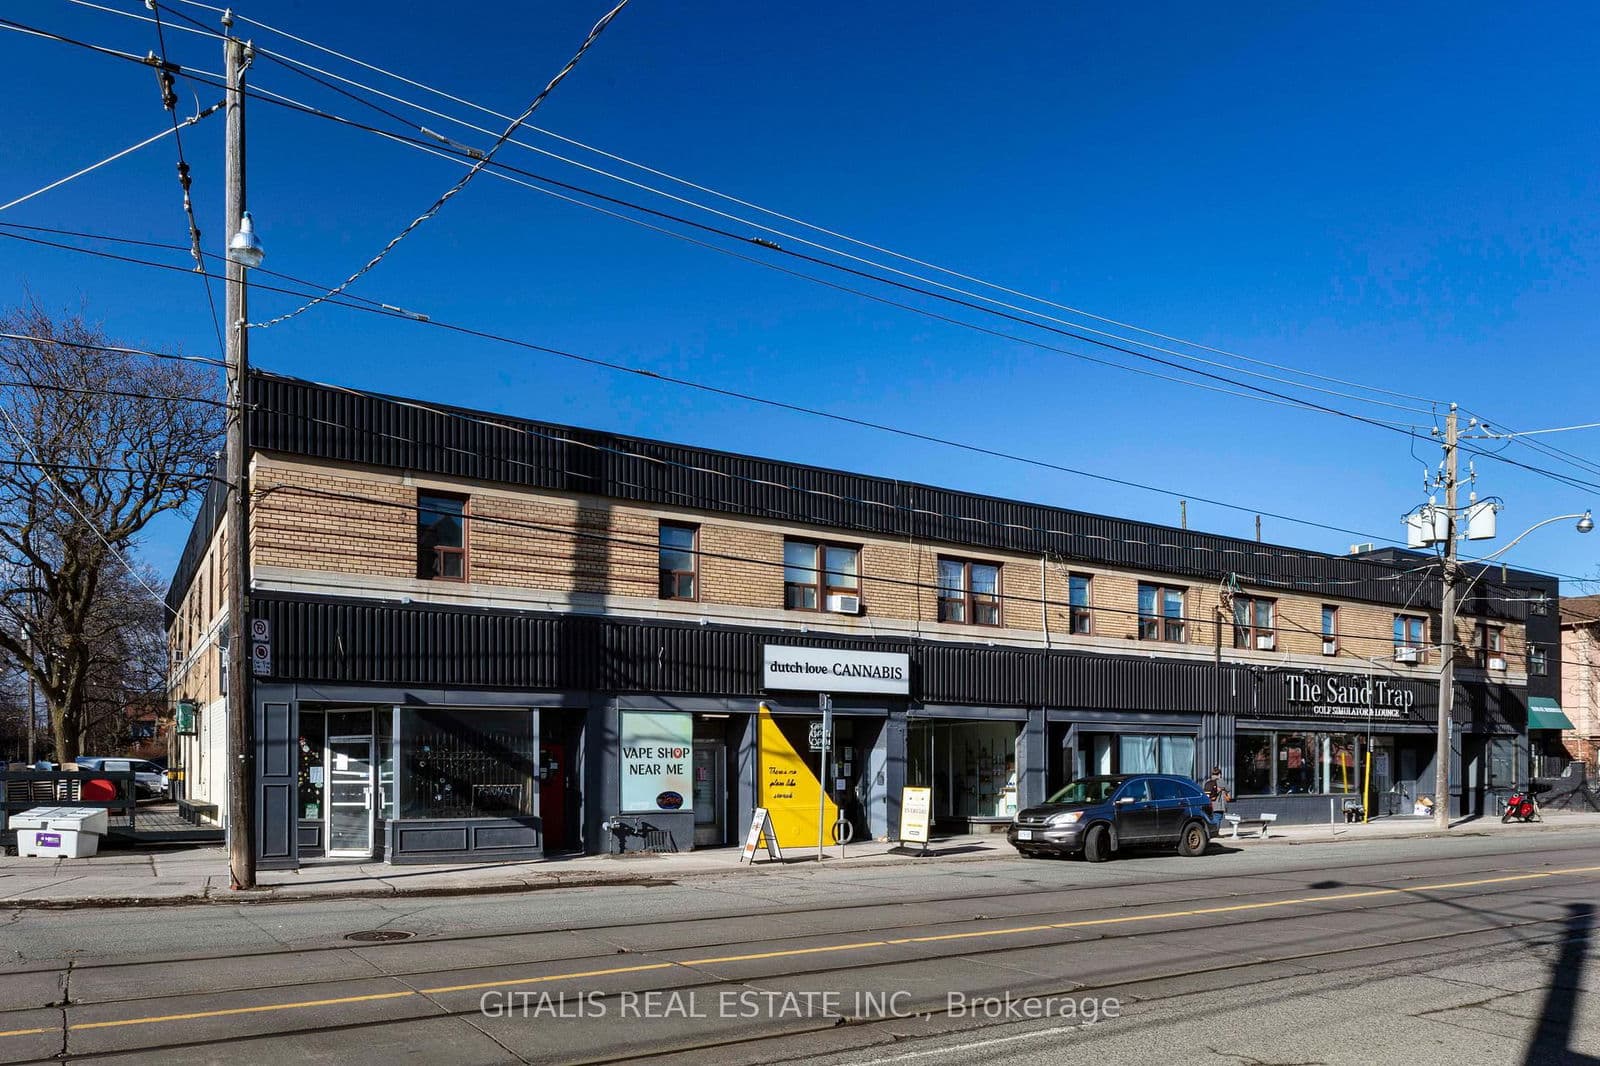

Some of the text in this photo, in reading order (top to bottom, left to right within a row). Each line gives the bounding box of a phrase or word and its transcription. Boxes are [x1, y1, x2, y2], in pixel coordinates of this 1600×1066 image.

[770, 661, 903, 680] dutch love CANNABIS
[1286, 674, 1414, 714] The Sand Trap
[623, 747, 690, 759] VAPE SHOP
[629, 764, 684, 775] NEAR ME
